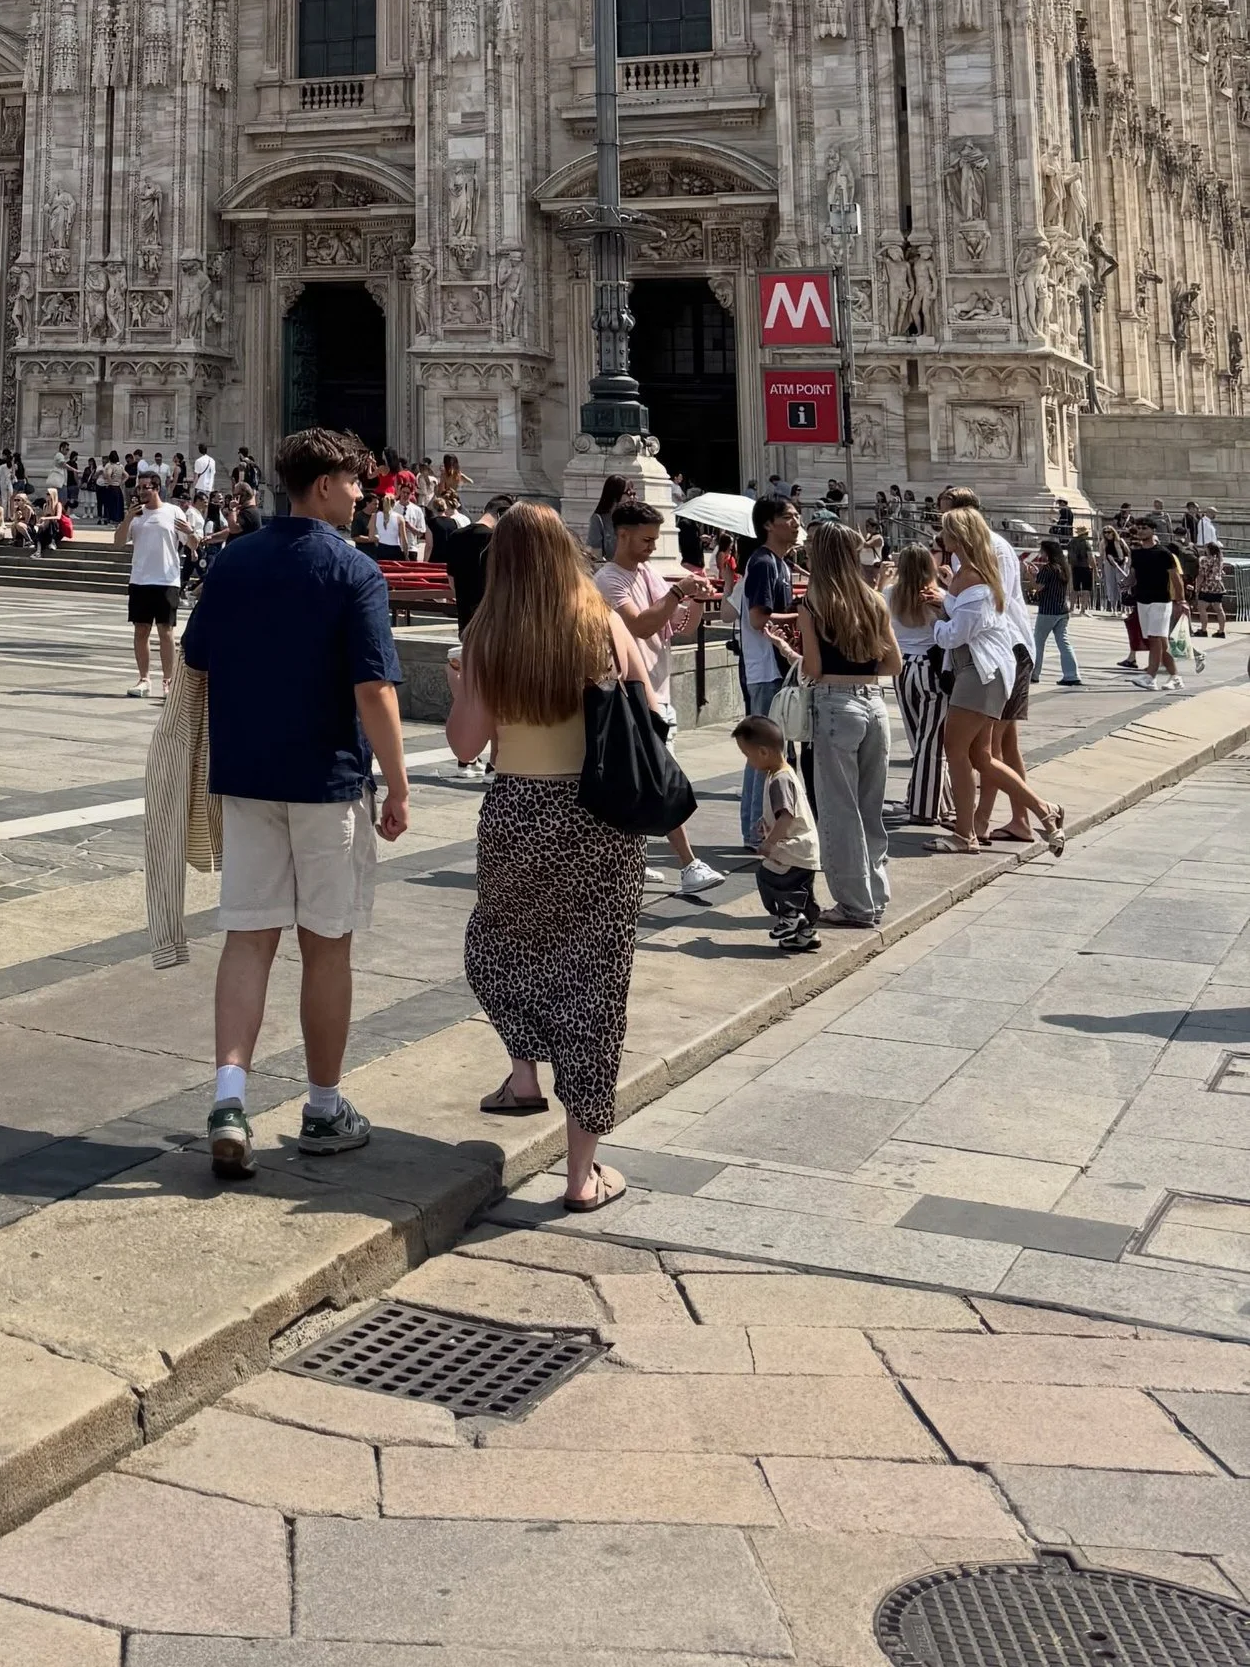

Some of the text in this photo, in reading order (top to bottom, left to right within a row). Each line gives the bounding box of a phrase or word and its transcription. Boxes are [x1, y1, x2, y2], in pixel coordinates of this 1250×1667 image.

[764, 282, 831, 329] M
[770, 384, 833, 395] ATM POINT
